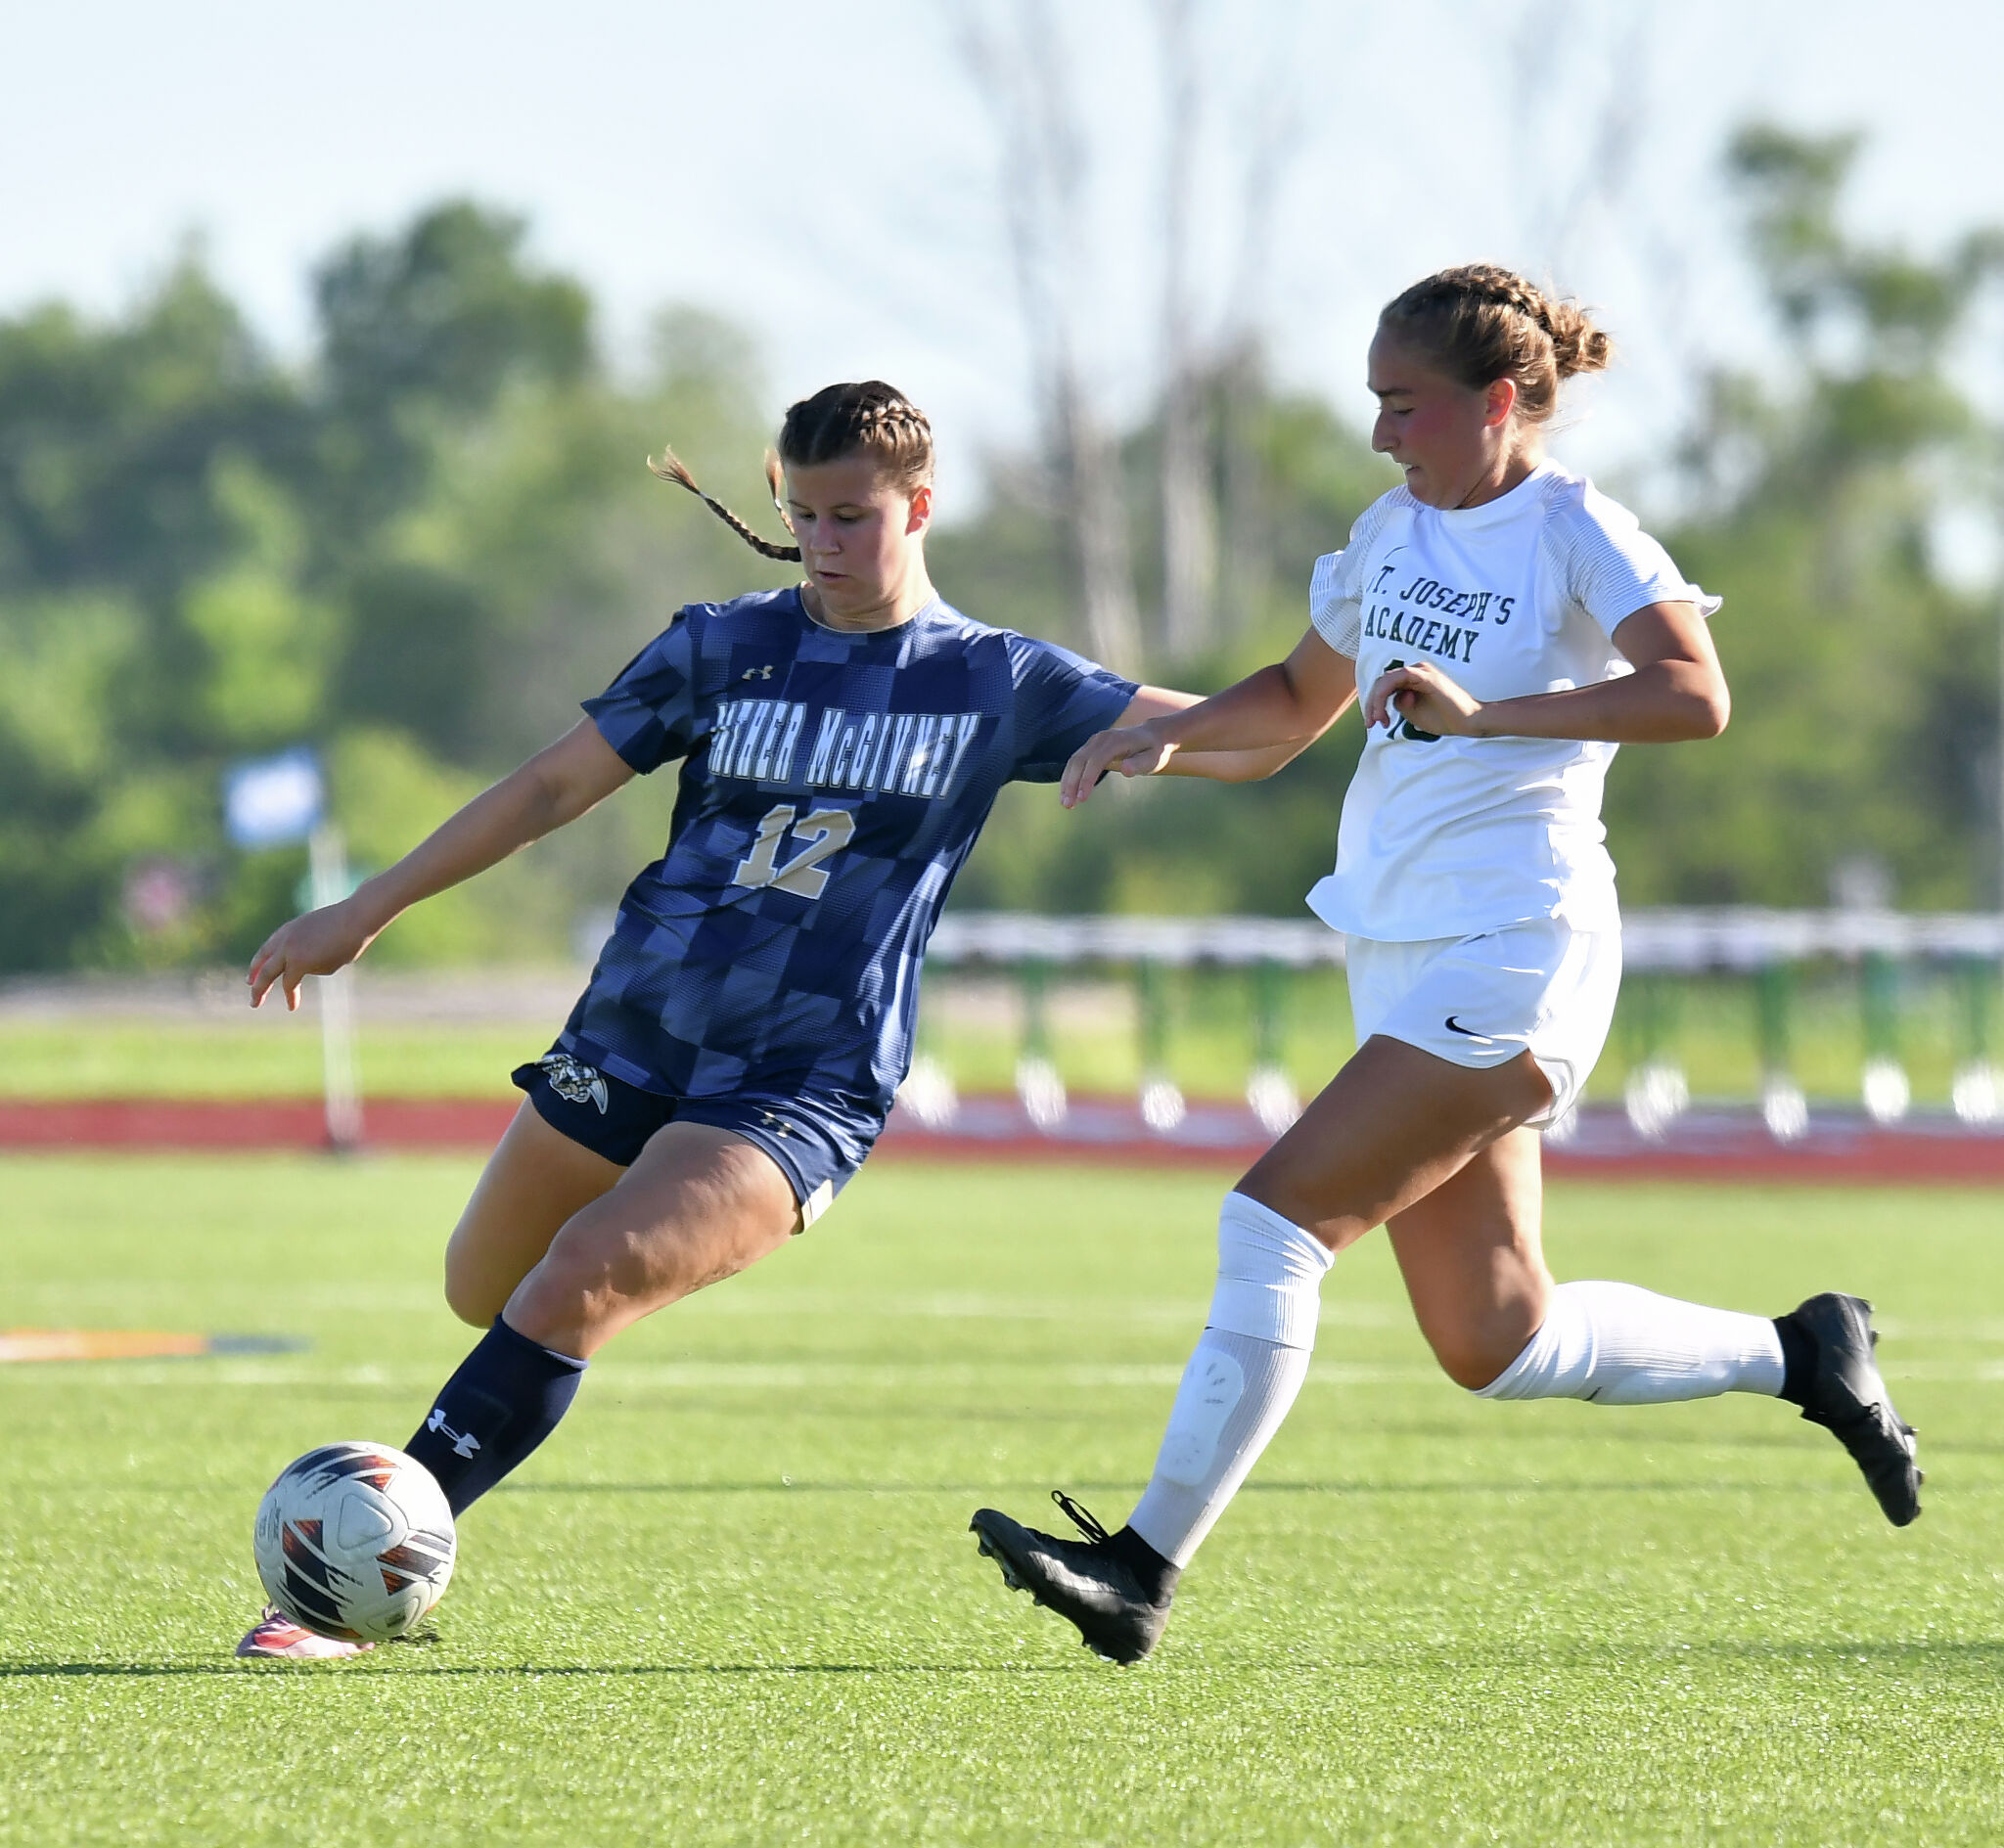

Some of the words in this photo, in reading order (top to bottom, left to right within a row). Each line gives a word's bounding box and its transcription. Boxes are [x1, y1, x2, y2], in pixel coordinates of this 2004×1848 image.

[1365, 564, 1396, 595] T.
[1399, 577, 1516, 625] JOSEPH'S
[1364, 604, 1480, 663] ACADEMY
[731, 805, 855, 900] 12
